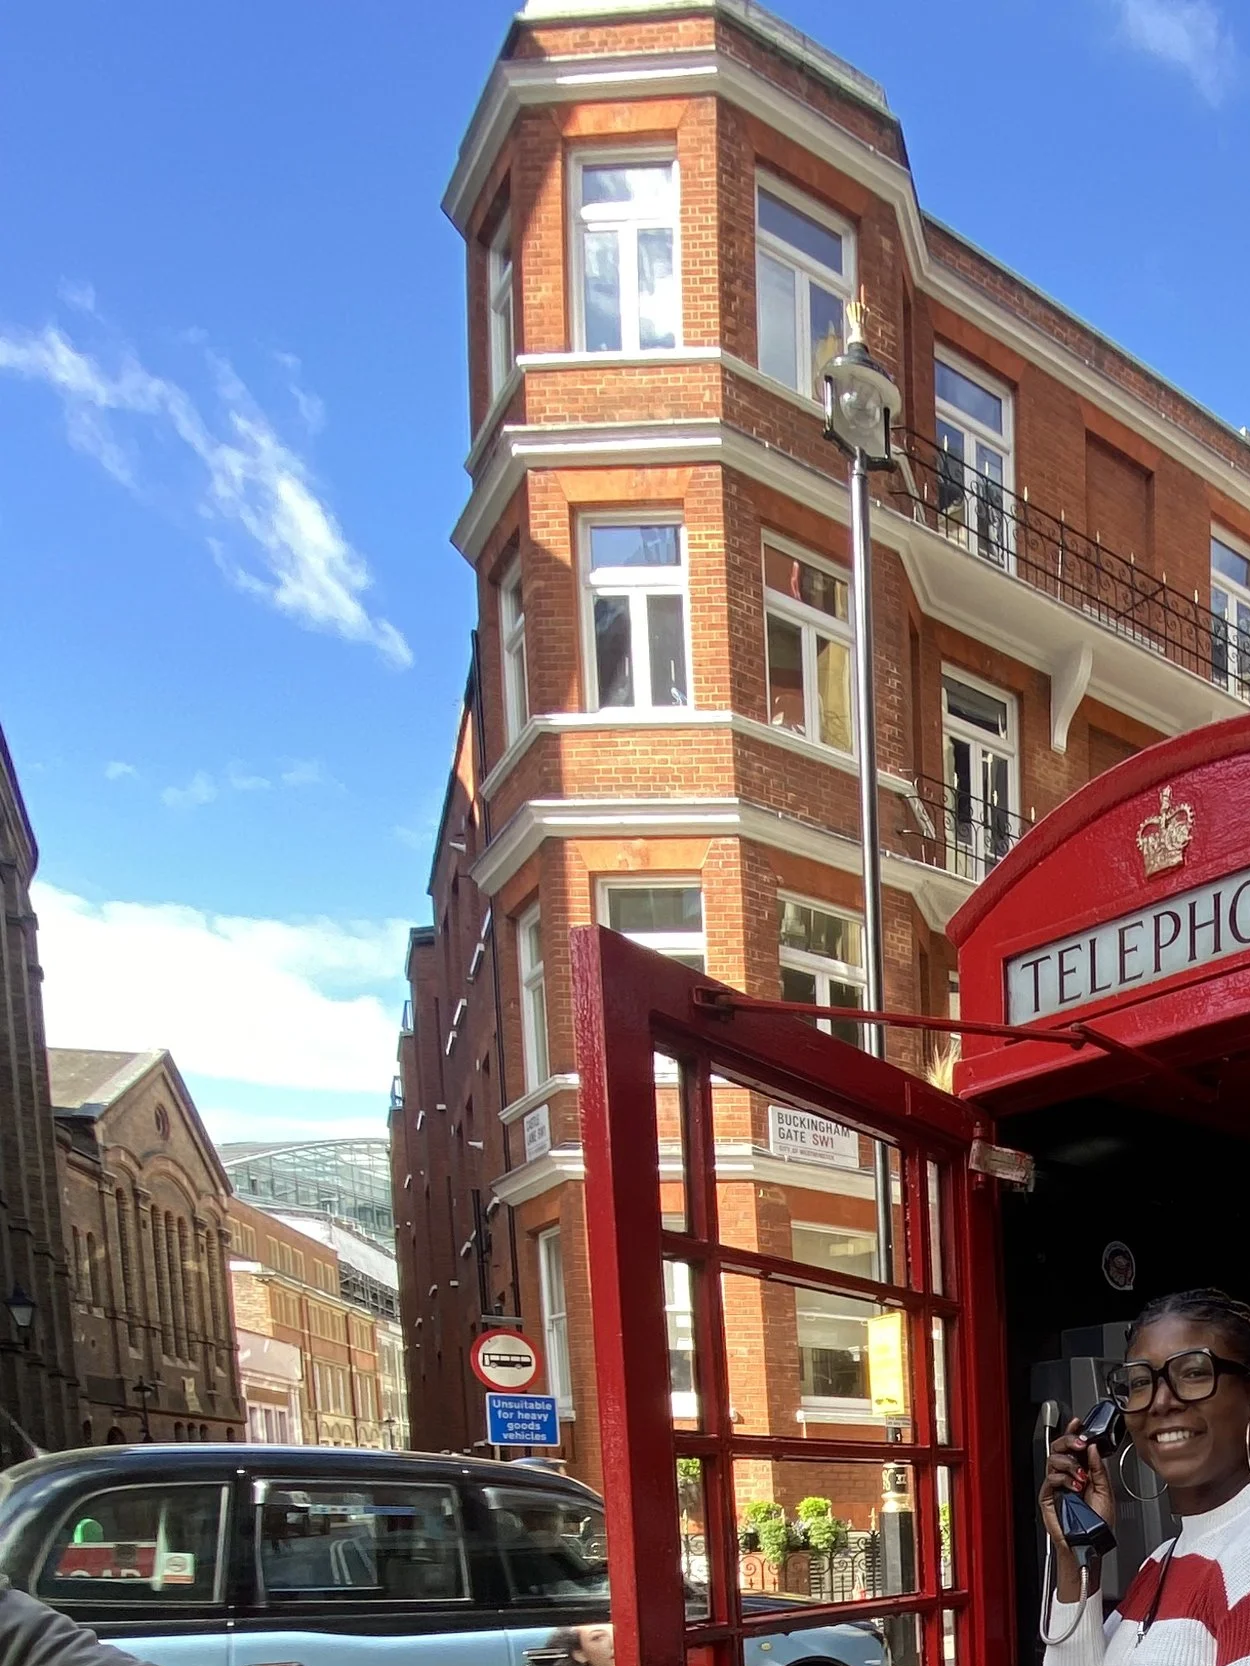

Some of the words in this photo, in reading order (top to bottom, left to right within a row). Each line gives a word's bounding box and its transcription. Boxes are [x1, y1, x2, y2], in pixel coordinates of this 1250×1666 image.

[777, 1111, 851, 1139] BUCKINGHAM
[778, 1126, 807, 1144] GATE
[811, 1133, 835, 1150] SW1
[492, 1399, 553, 1411] Unsuitable
[497, 1410, 514, 1420] for
[517, 1410, 549, 1422] heavy
[506, 1421, 542, 1431] goods
[502, 1431, 547, 1441] vehicles
